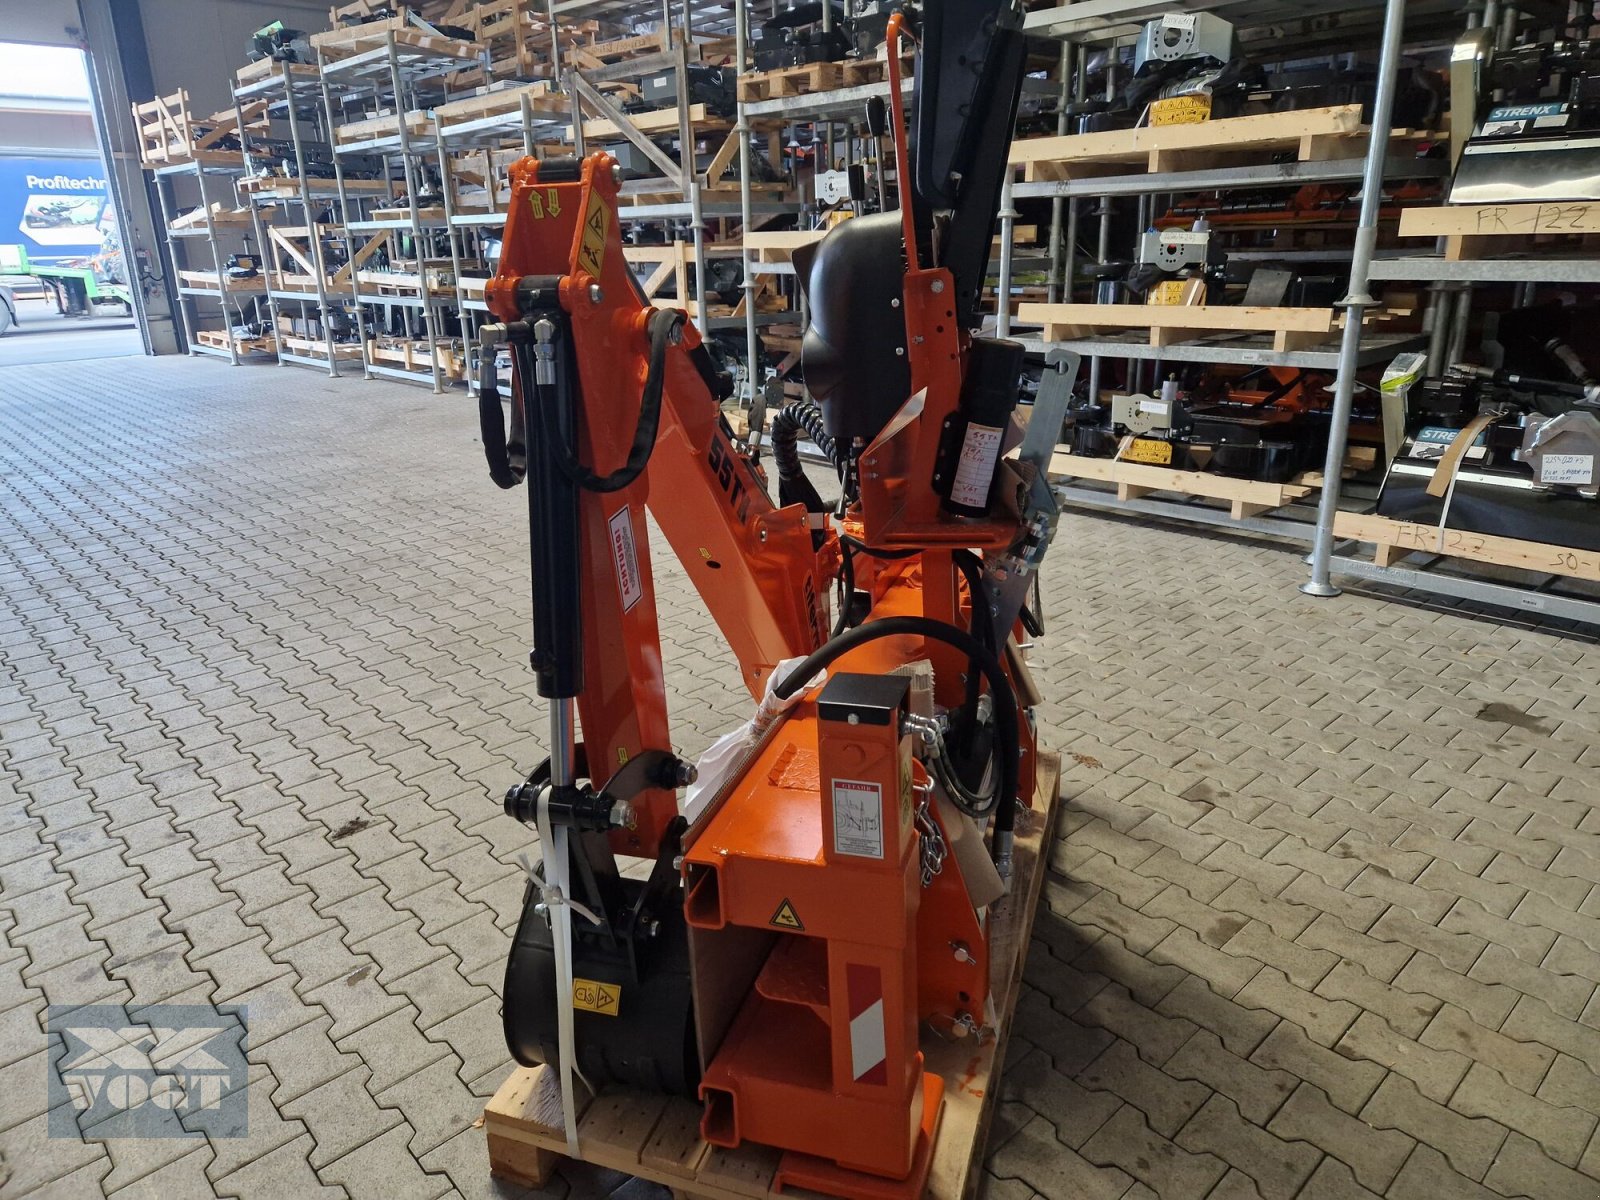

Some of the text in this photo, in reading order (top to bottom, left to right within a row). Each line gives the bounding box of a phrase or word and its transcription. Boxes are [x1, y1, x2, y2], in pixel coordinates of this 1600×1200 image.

[1494, 105, 1553, 118] STRENX
[1422, 430, 1458, 441] STRE
[614, 528, 630, 596] ACHTUNG!
